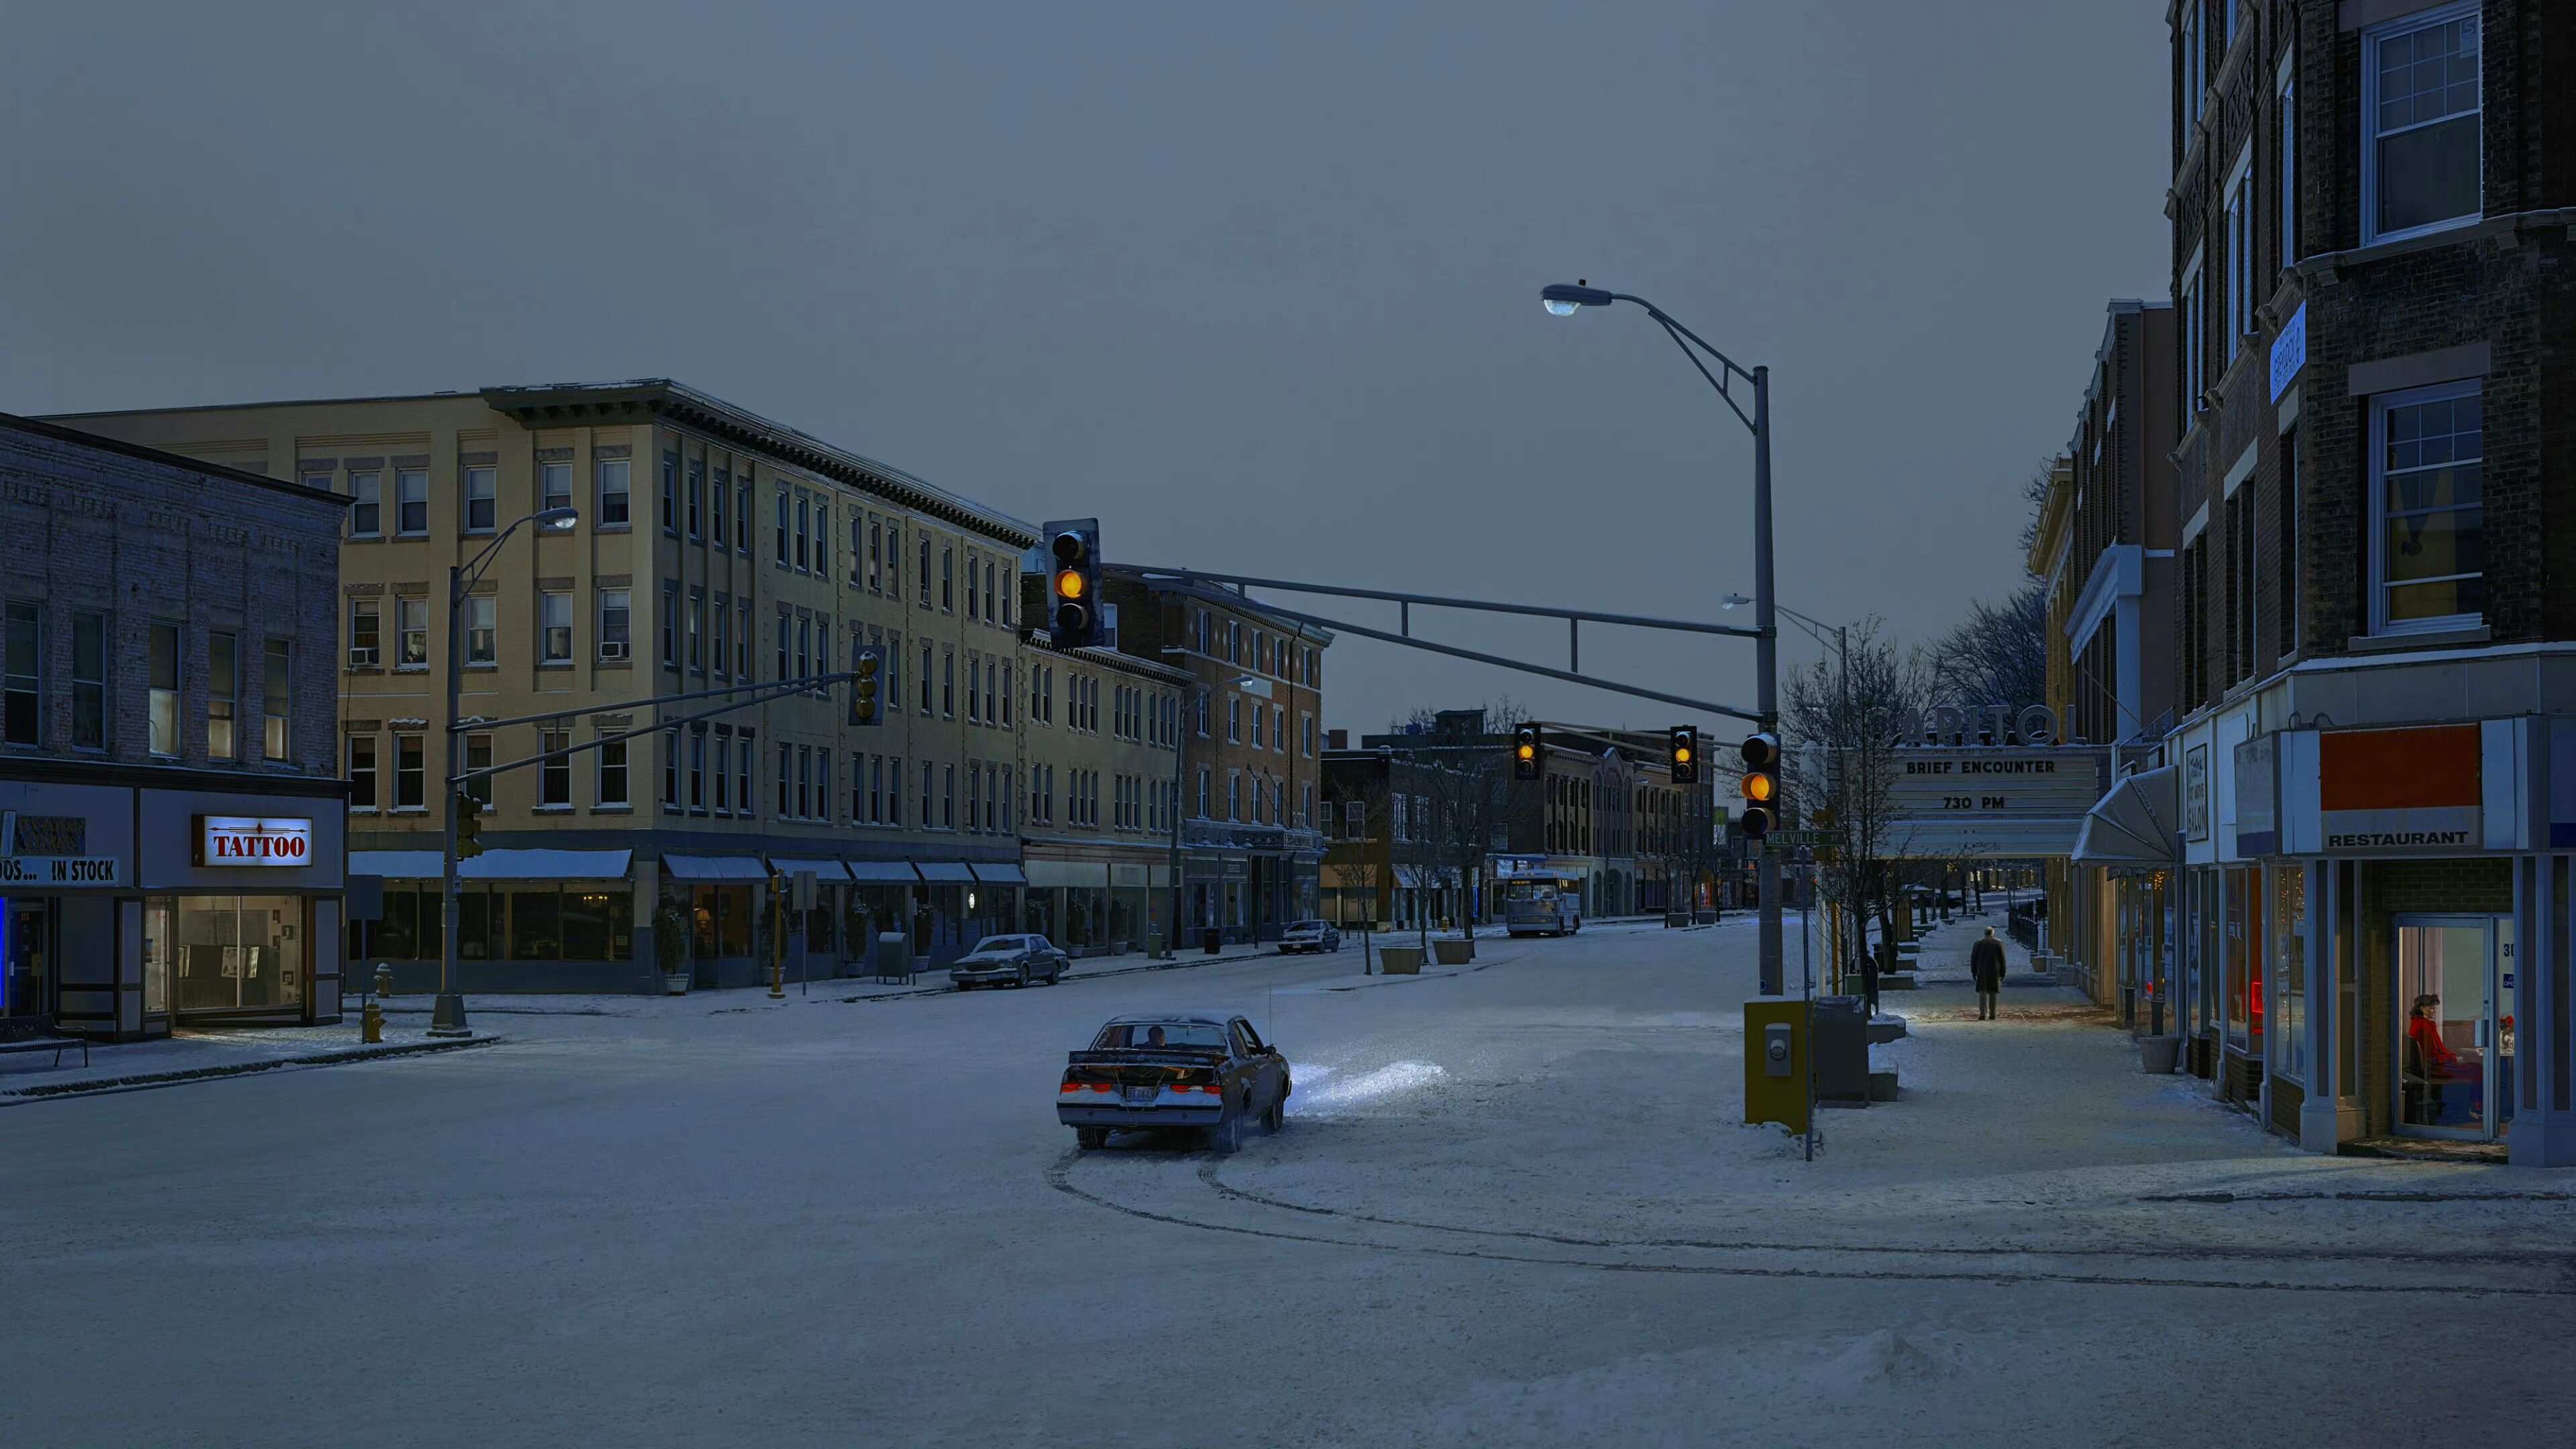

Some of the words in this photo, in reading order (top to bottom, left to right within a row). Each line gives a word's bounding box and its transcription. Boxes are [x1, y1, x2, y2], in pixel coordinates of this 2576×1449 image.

[1907, 761, 1953, 773] BRIEF
[1962, 760, 2055, 773] ENCOUNTER
[1943, 797, 1972, 809] 730
[1982, 796, 2004, 809] PM
[2188, 804, 2206, 834] SALON
[1766, 832, 1820, 844] MELVILLE
[2328, 831, 2469, 847] RESTAURANT
[213, 836, 305, 857] TATTOO
[52, 861, 66, 881] IN
[71, 860, 114, 881] STOCK
